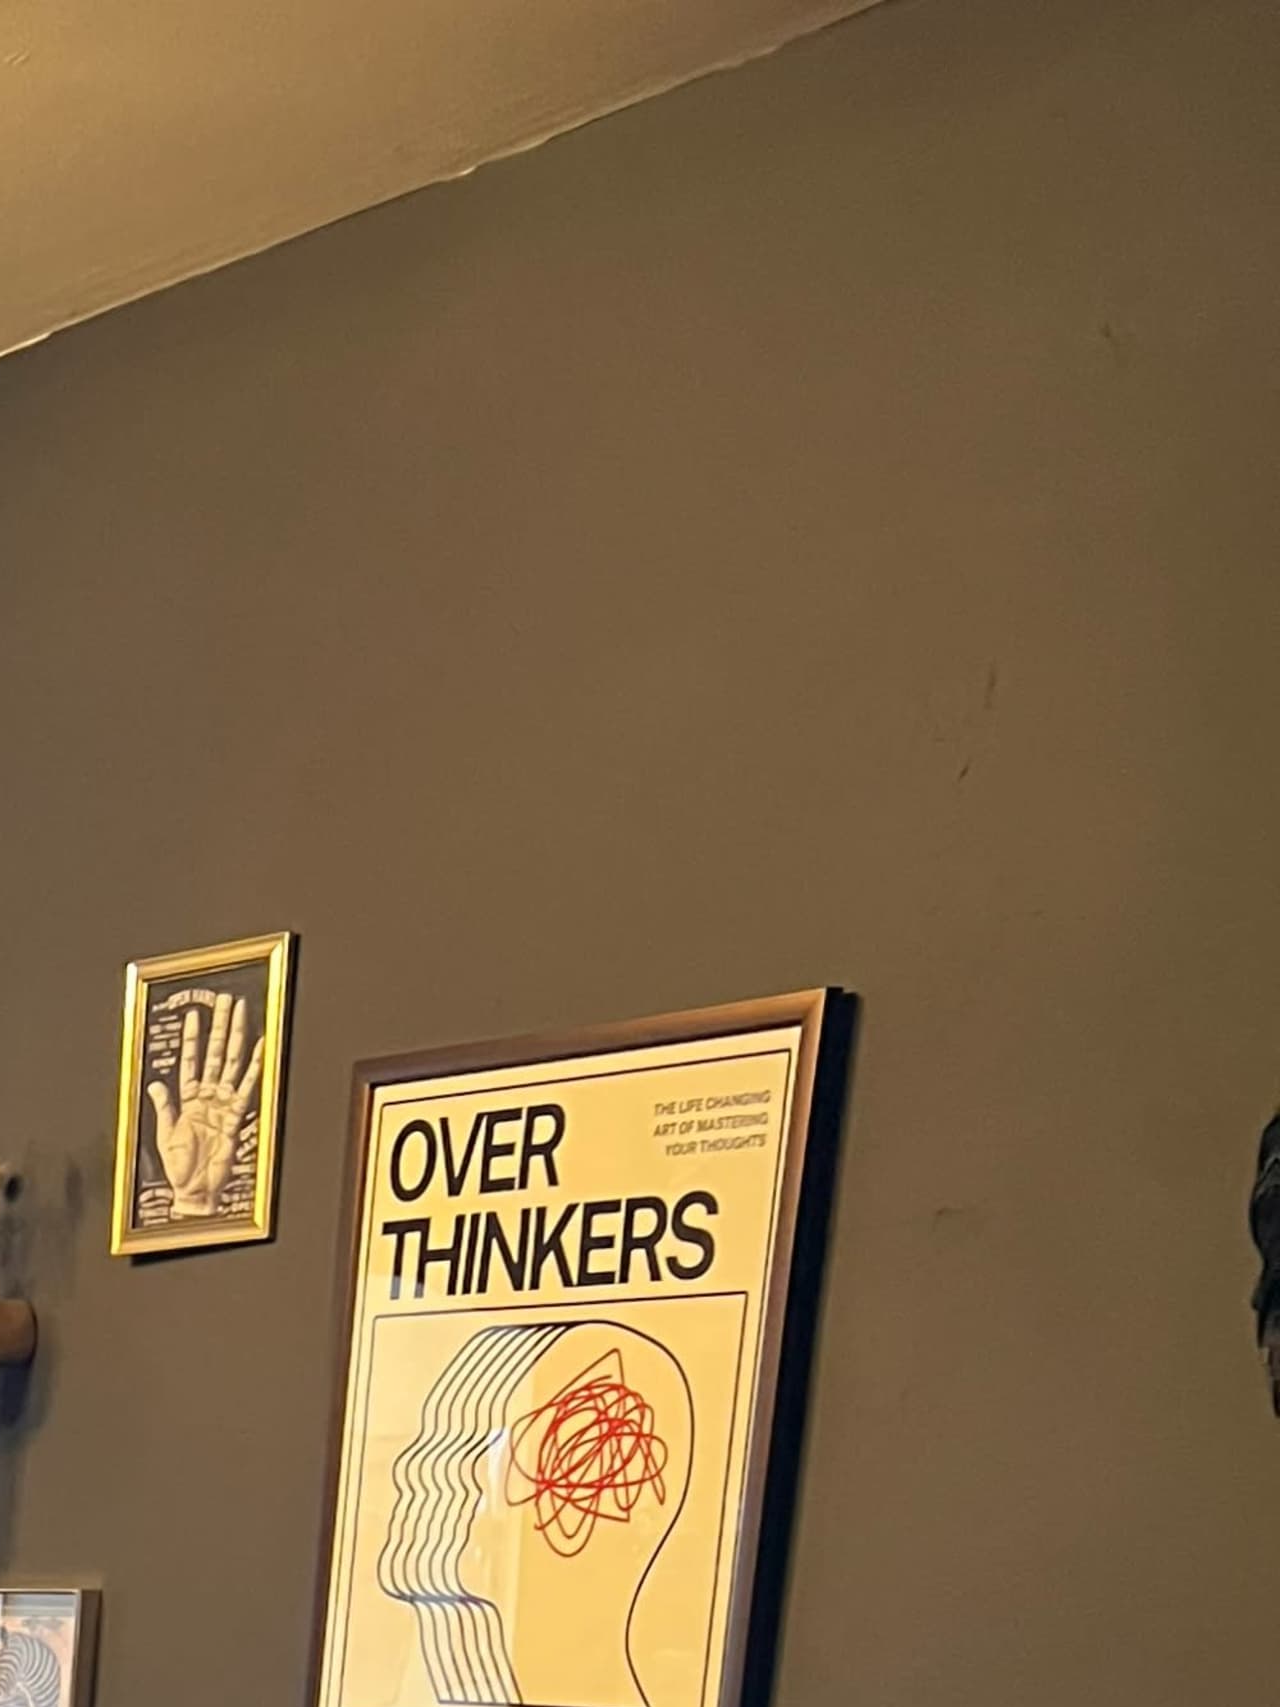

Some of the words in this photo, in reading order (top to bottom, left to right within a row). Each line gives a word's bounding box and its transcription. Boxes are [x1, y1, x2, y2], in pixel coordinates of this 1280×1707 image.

[654, 1102, 676, 1116] THE
[679, 1098, 703, 1114] LIFE
[705, 1089, 771, 1110] CHANGING
[653, 1122, 677, 1137] ART
[679, 1119, 695, 1135] OF
[697, 1111, 769, 1132] MASTERING
[390, 1104, 566, 1202] OVER
[665, 1141, 697, 1156] YOUR
[700, 1133, 767, 1153] THOUGHTS
[382, 1191, 719, 1300] THINKERS
